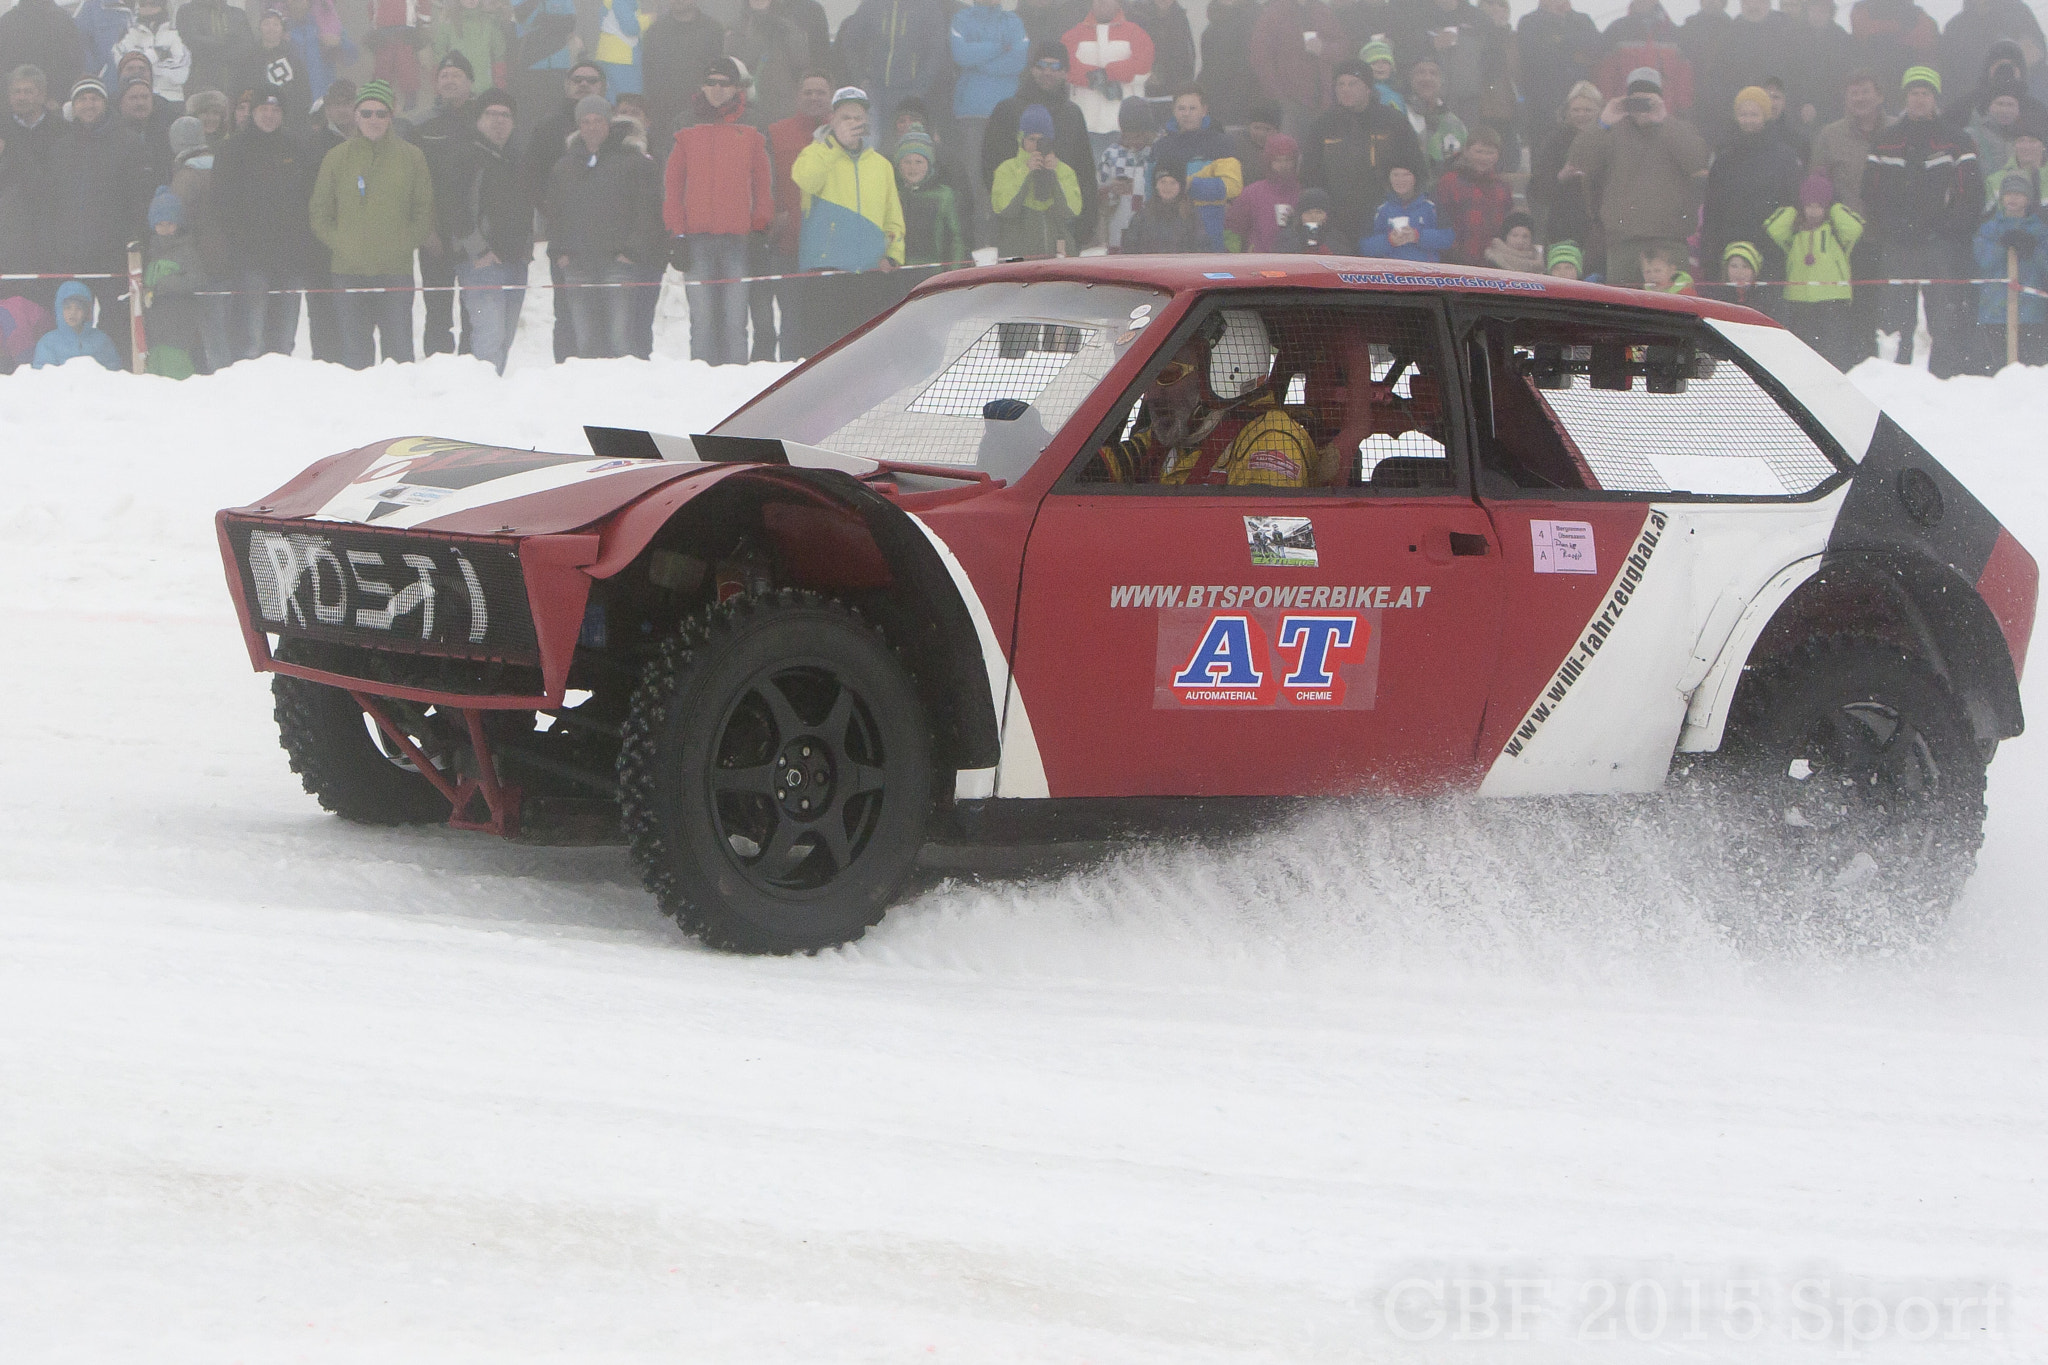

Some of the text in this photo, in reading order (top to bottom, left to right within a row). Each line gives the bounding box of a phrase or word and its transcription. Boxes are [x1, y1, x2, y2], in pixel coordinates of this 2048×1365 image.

[1338, 273, 1545, 291] www.Rennsportshop.com
[1539, 530, 1544, 539] 4
[1540, 550, 1547, 560] A
[1110, 585, 1432, 608] WWW.BTSPOWERBIKE.AT
[1185, 691, 1332, 701] AUTOMATERIAL CHEMIE
